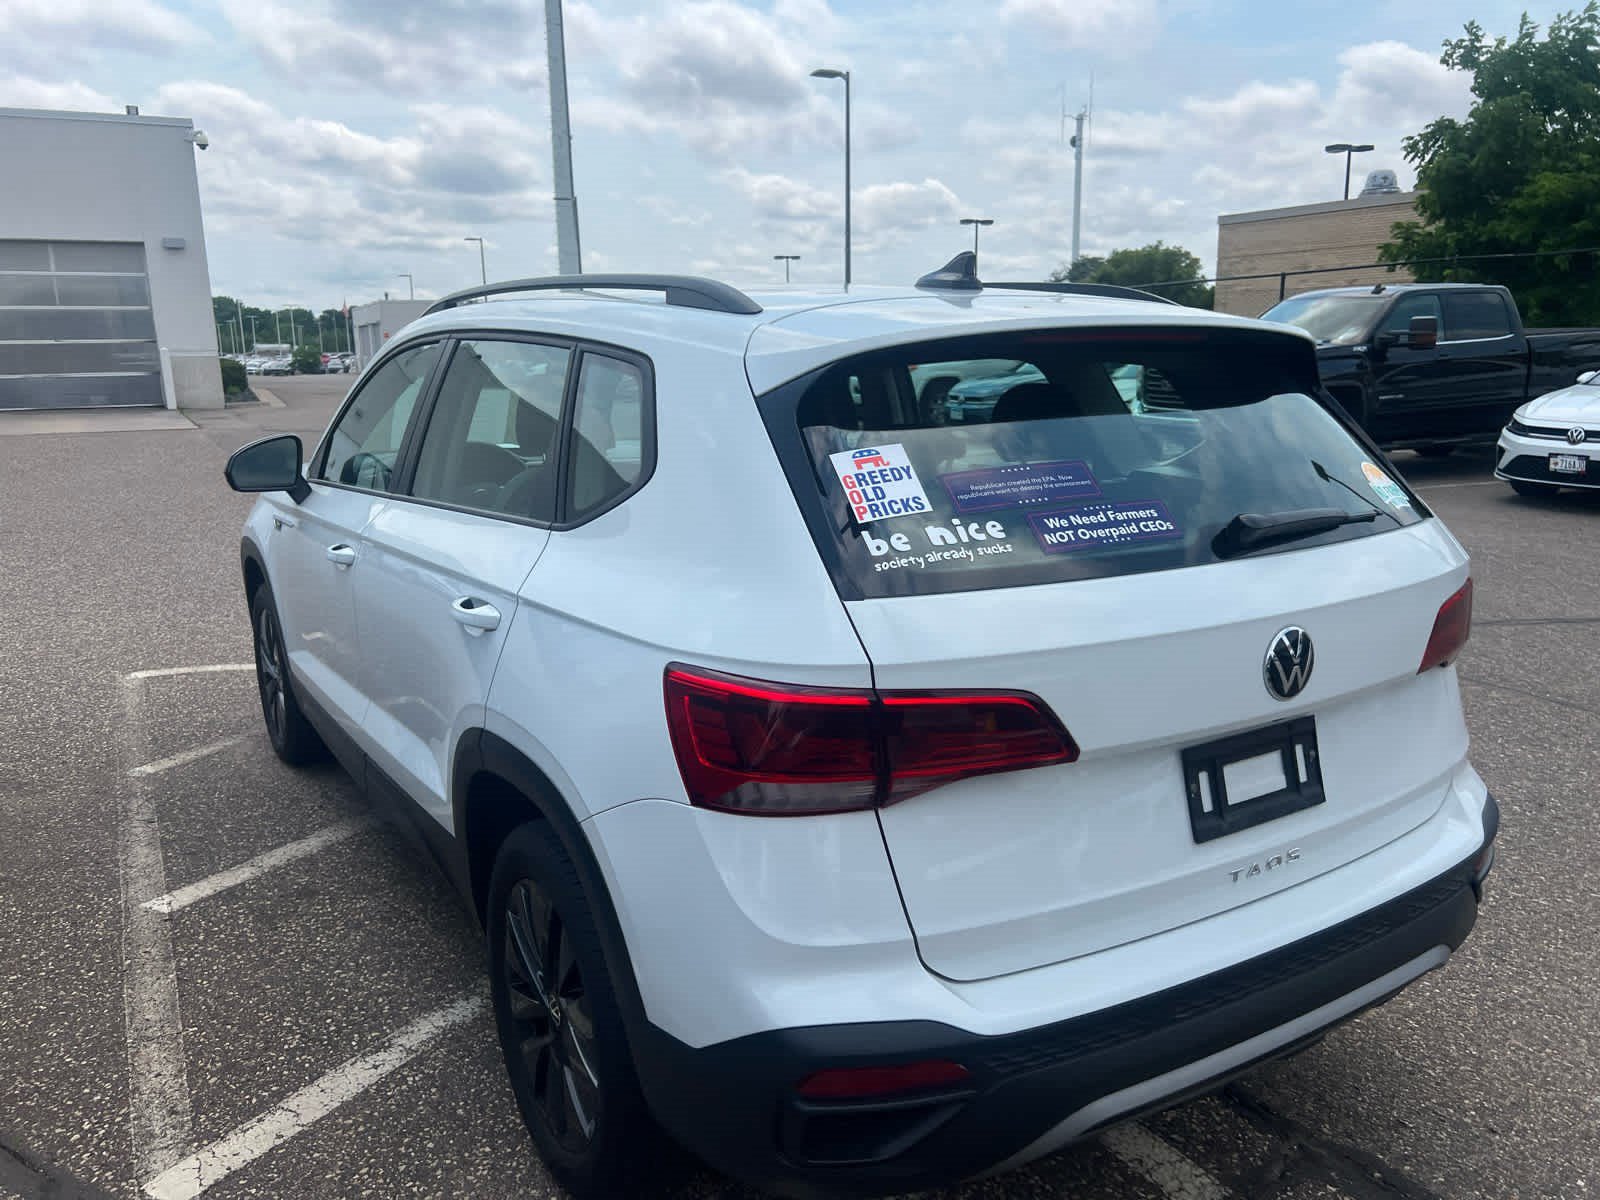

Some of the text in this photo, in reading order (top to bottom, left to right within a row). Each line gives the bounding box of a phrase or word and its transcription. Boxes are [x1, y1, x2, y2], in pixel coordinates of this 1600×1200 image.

[841, 465, 913, 490] GREEDY
[969, 482, 1007, 492] Republican
[1007, 477, 1030, 486] created
[848, 485, 886, 505] OLD
[957, 489, 995, 500] republicans
[995, 487, 1012, 495] want
[1019, 483, 1044, 494] destroy
[855, 496, 926, 521] PRICKS
[1044, 508, 1158, 529] We Need Farmers
[861, 518, 1007, 557] be nice
[1044, 520, 1174, 545] NOT Overpaid CEOs
[874, 543, 1013, 572] society already sucks
[1228, 847, 1301, 882] TAOS
